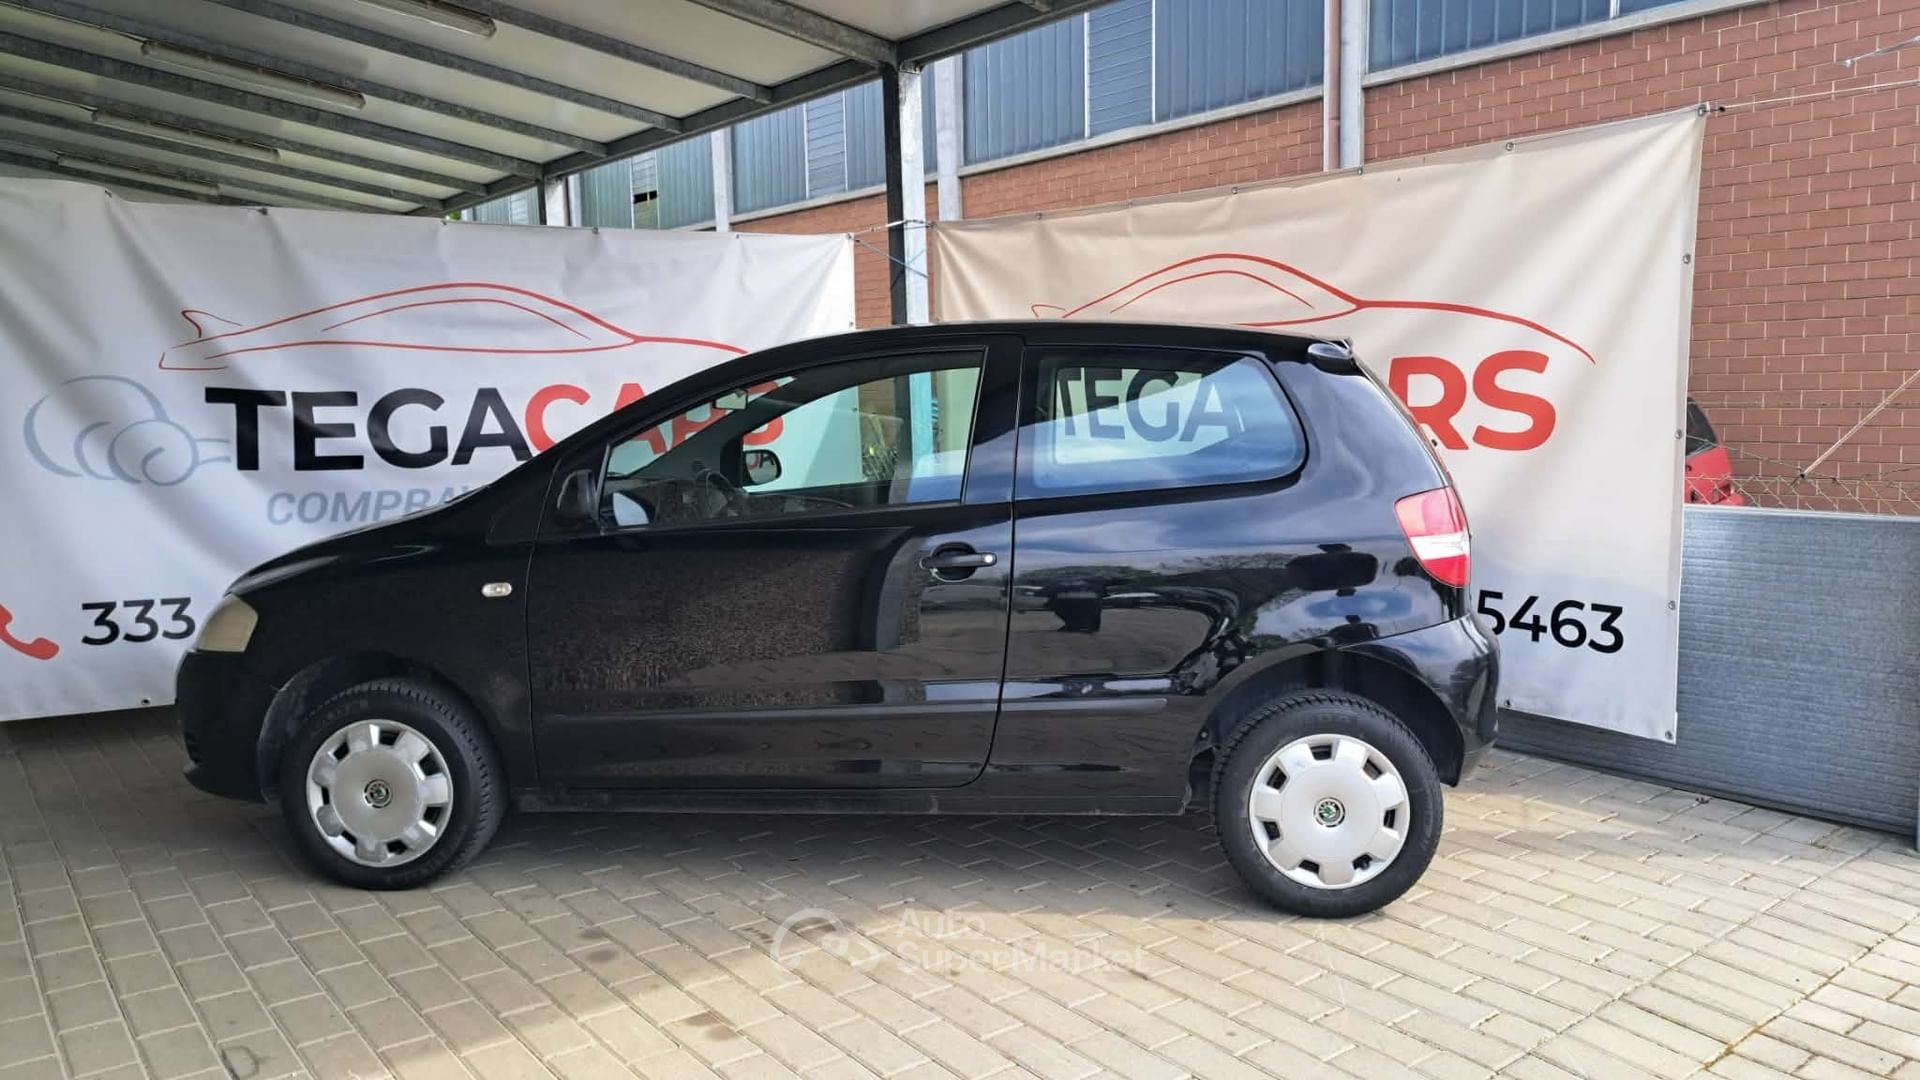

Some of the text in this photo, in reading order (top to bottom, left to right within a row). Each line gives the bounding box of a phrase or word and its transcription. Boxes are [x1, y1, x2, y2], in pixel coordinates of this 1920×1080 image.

[266, 486, 470, 526] COMPRA
[81, 597, 196, 646] 333
[1477, 589, 1624, 654] 5463
